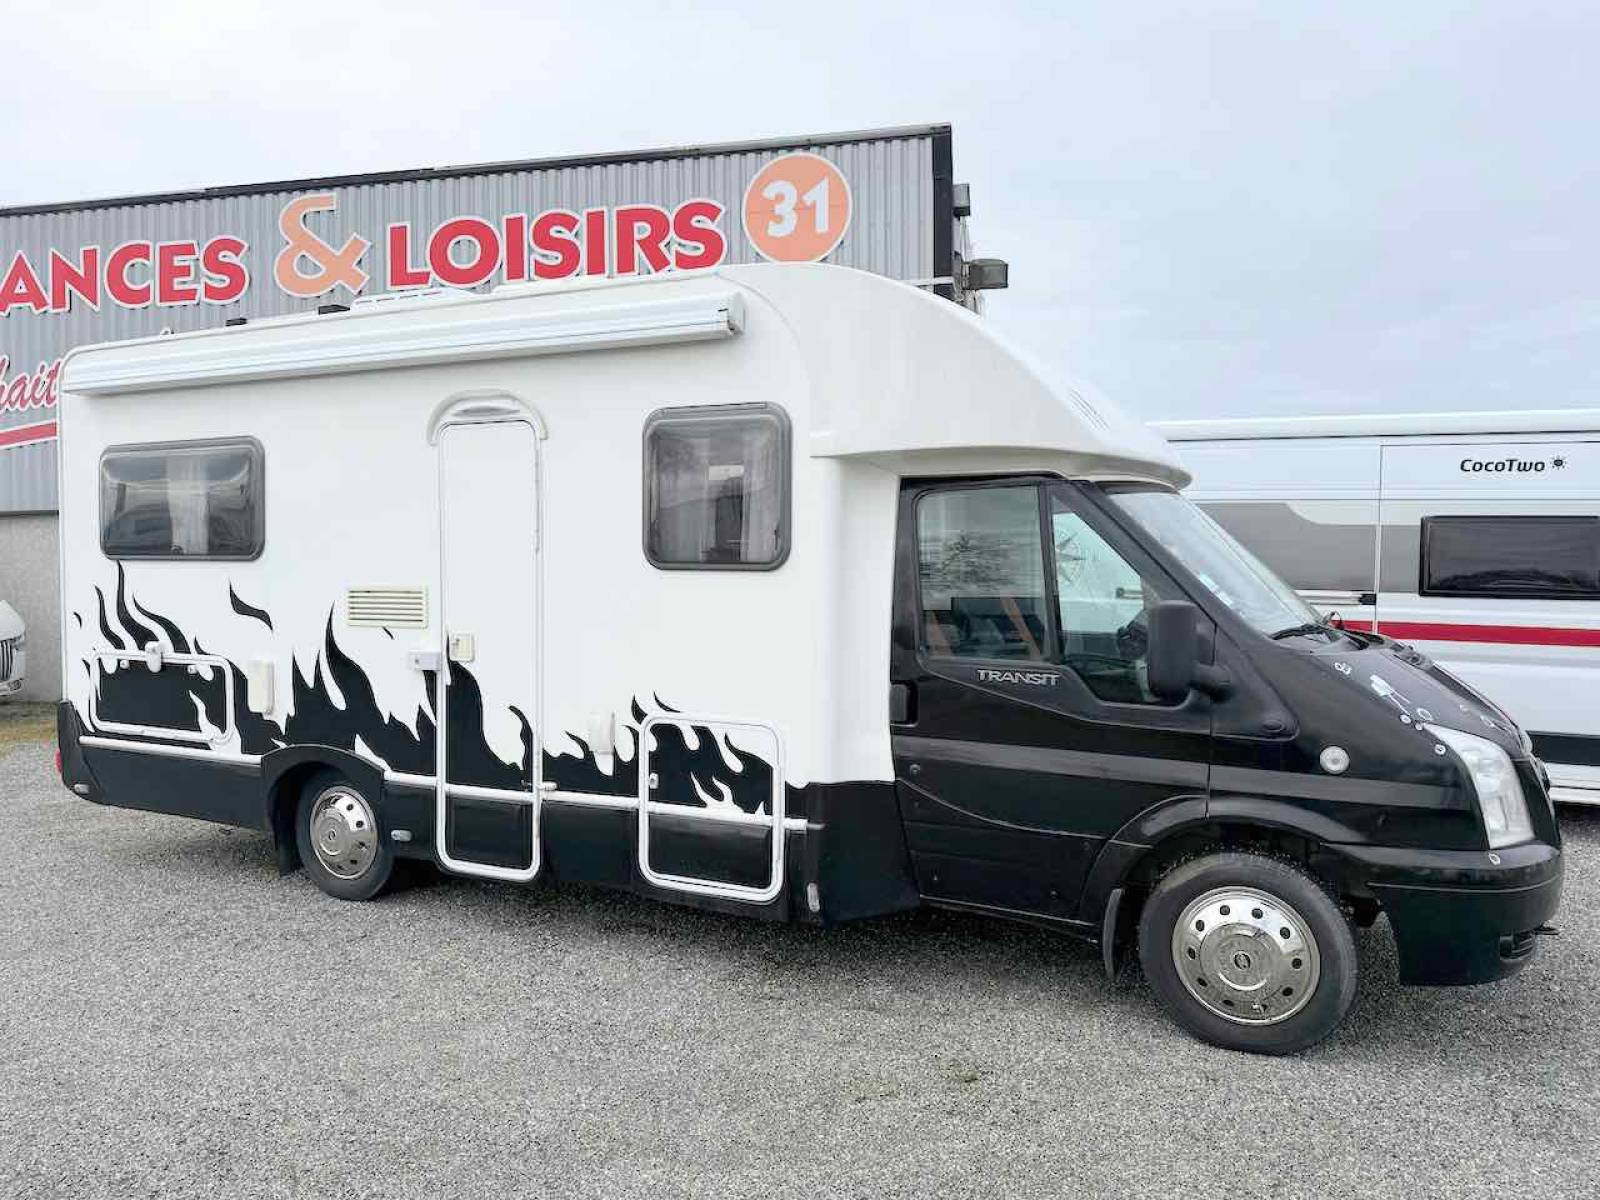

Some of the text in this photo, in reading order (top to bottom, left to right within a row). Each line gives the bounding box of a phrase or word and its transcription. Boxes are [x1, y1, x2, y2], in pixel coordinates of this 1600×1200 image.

[0, 175, 831, 315] ANCES & LOISIRS 31
[1460, 459, 1546, 472] CocoTwo
[977, 669, 1060, 686] TRANSIT
